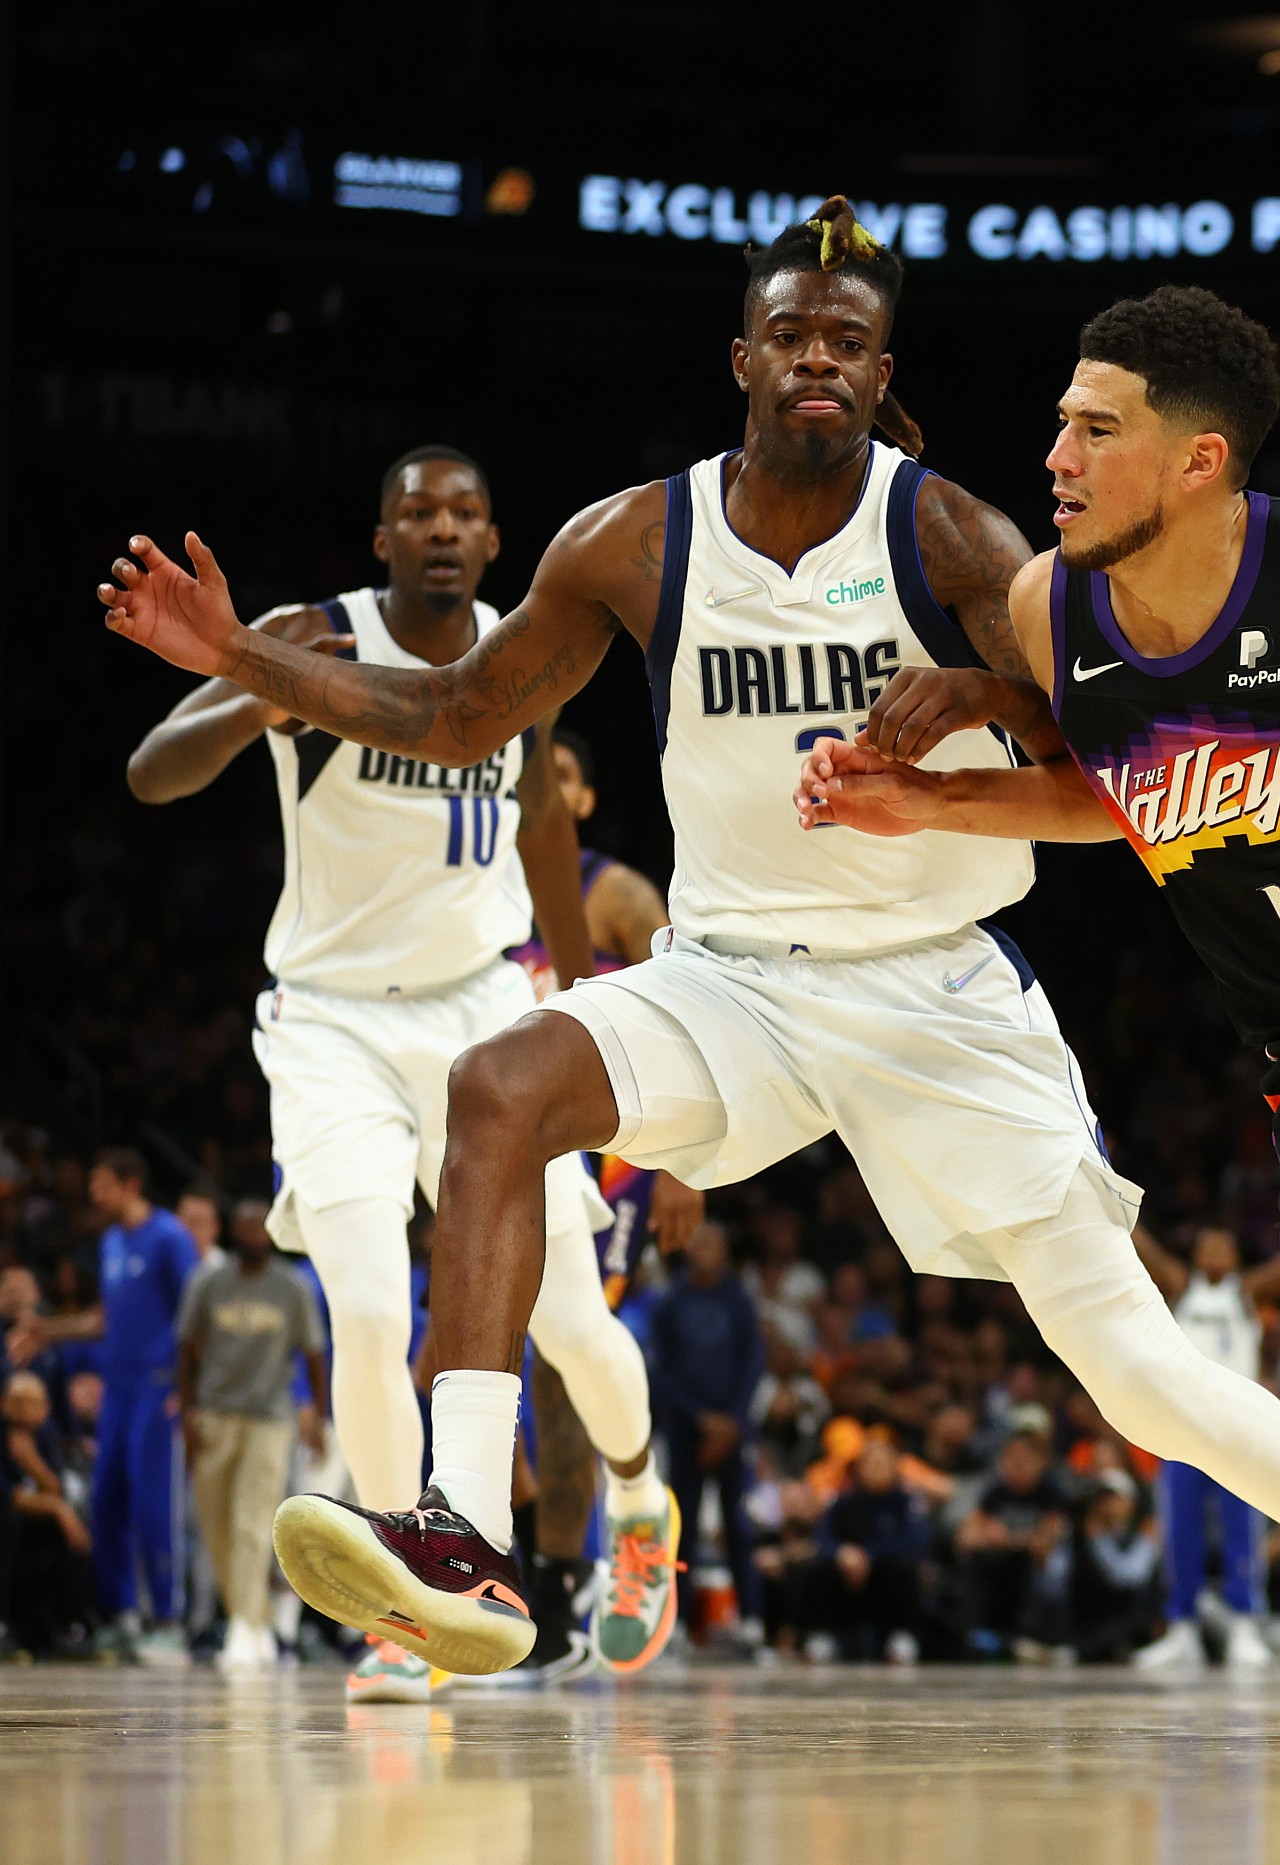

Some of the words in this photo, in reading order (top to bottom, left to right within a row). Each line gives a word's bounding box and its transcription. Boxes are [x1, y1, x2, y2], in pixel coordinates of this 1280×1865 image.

[579, 174, 948, 259] EXCLUVE
[968, 202, 1233, 261] CASINO
[826, 577, 886, 604] chime
[697, 638, 902, 717] DALLAS
[1228, 669, 1280, 688] PayPal
[1133, 765, 1167, 790] THE
[443, 794, 499, 867] 10
[459, 1560, 473, 1575] 001
